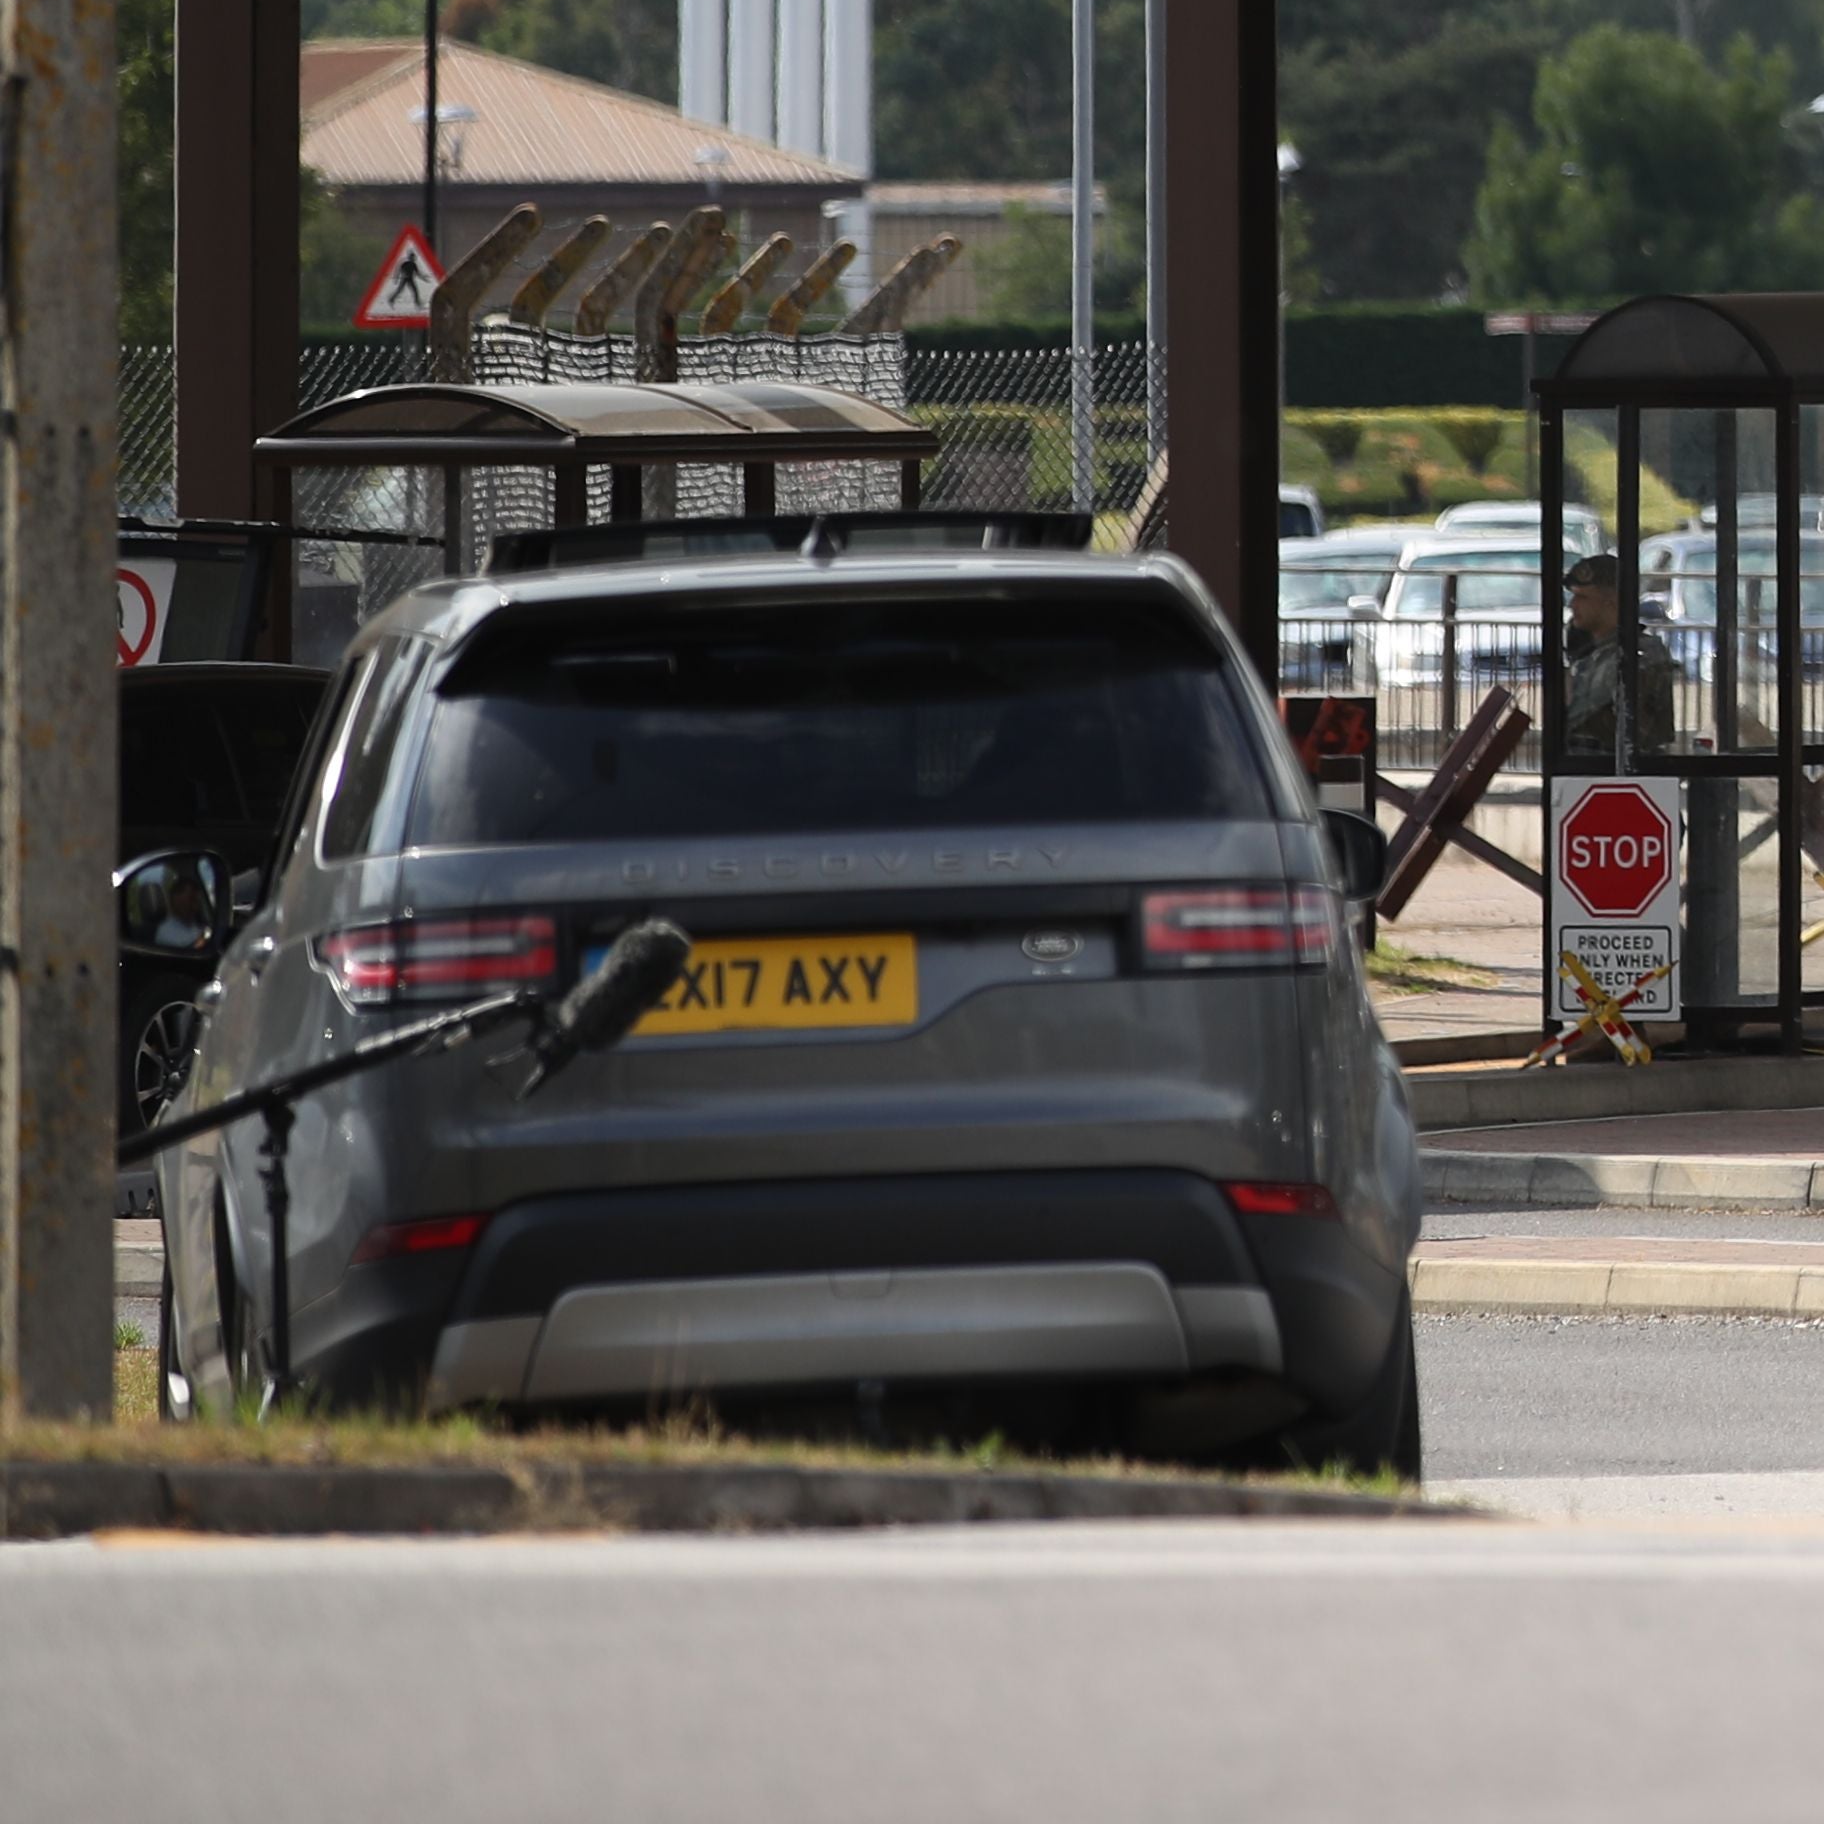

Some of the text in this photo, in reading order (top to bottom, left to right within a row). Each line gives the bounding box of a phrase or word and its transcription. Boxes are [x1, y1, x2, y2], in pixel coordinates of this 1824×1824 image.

[621, 847, 1068, 882] DISCOVERY
[1571, 835, 1661, 869] STOP
[1577, 935, 1653, 951] PROCEED
[1573, 954, 1664, 969] NLY WHEN
[655, 954, 888, 1011] X17 AXY
